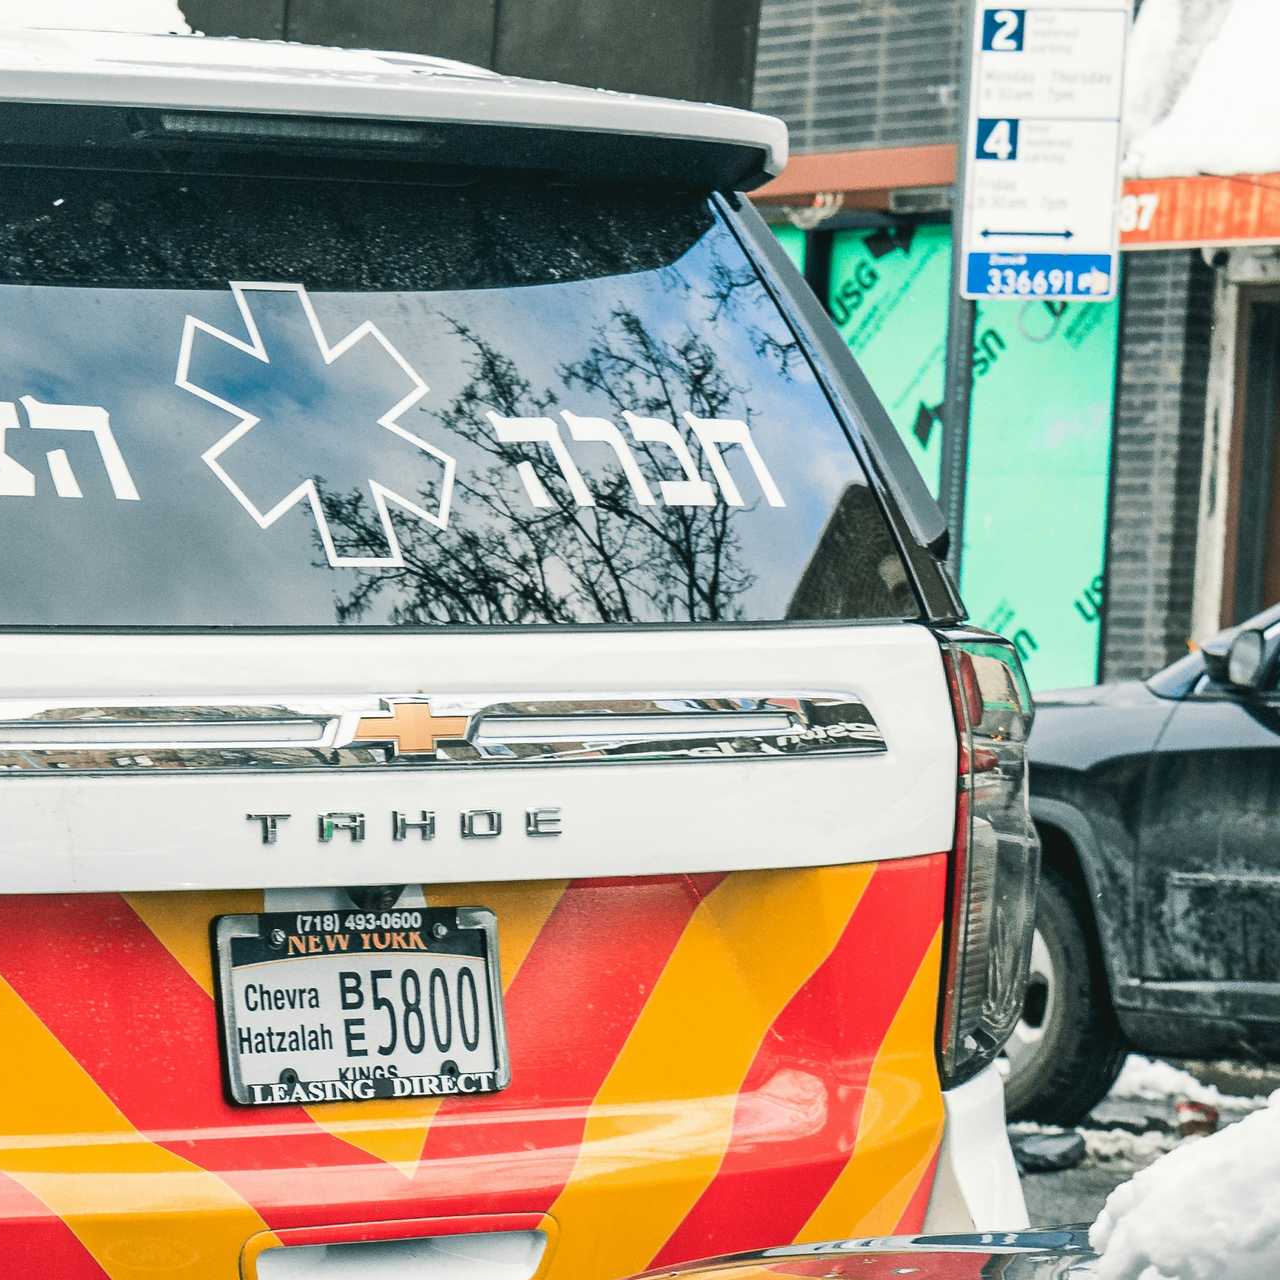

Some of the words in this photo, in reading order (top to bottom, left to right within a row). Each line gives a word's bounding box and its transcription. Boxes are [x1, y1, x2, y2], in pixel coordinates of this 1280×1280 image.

[992, 11, 1018, 50] 2
[983, 121, 1012, 160] 4
[830, 260, 880, 327] USG
[987, 269, 1073, 294] 336691
[486, 410, 786, 508] חברה
[244, 805, 564, 845] TAHOE
[296, 913, 340, 933] (718)
[344, 911, 422, 931] 493-0600
[287, 932, 350, 955] NEW
[361, 930, 428, 951] YORK
[244, 983, 320, 1011] Chevra
[238, 1023, 334, 1054] Hatzalah
[251, 1079, 376, 1104] LEASING
[392, 1072, 494, 1098] DIRECT
[338, 1064, 398, 1082] KINGS
